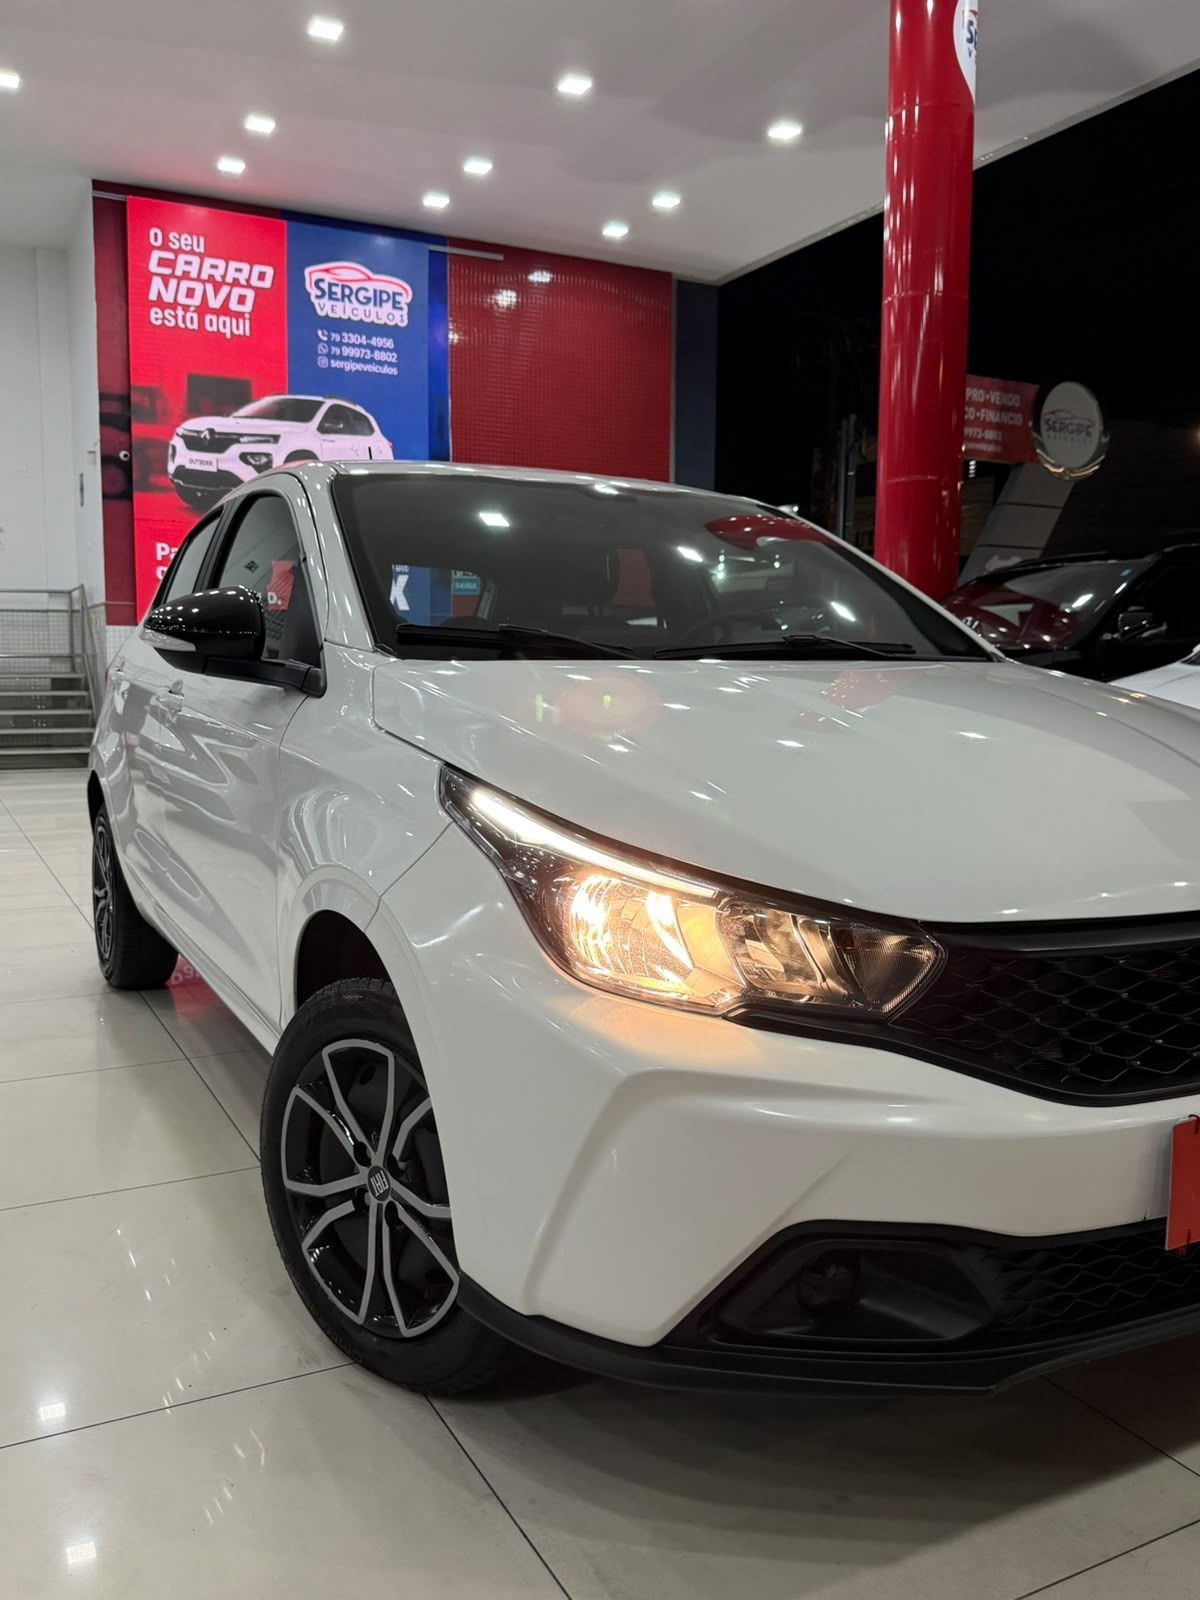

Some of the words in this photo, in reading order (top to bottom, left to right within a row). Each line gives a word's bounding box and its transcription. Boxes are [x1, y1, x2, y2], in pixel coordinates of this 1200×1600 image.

[168, 231, 205, 254] seu
[148, 249, 275, 289] CARRO
[148, 275, 255, 313] NOVO
[313, 278, 404, 311] SERGIPE
[149, 306, 199, 331] está
[204, 313, 251, 339] aqui
[1044, 417, 1094, 437] SERGIPE
[370, 1169, 390, 1197] FIAT
